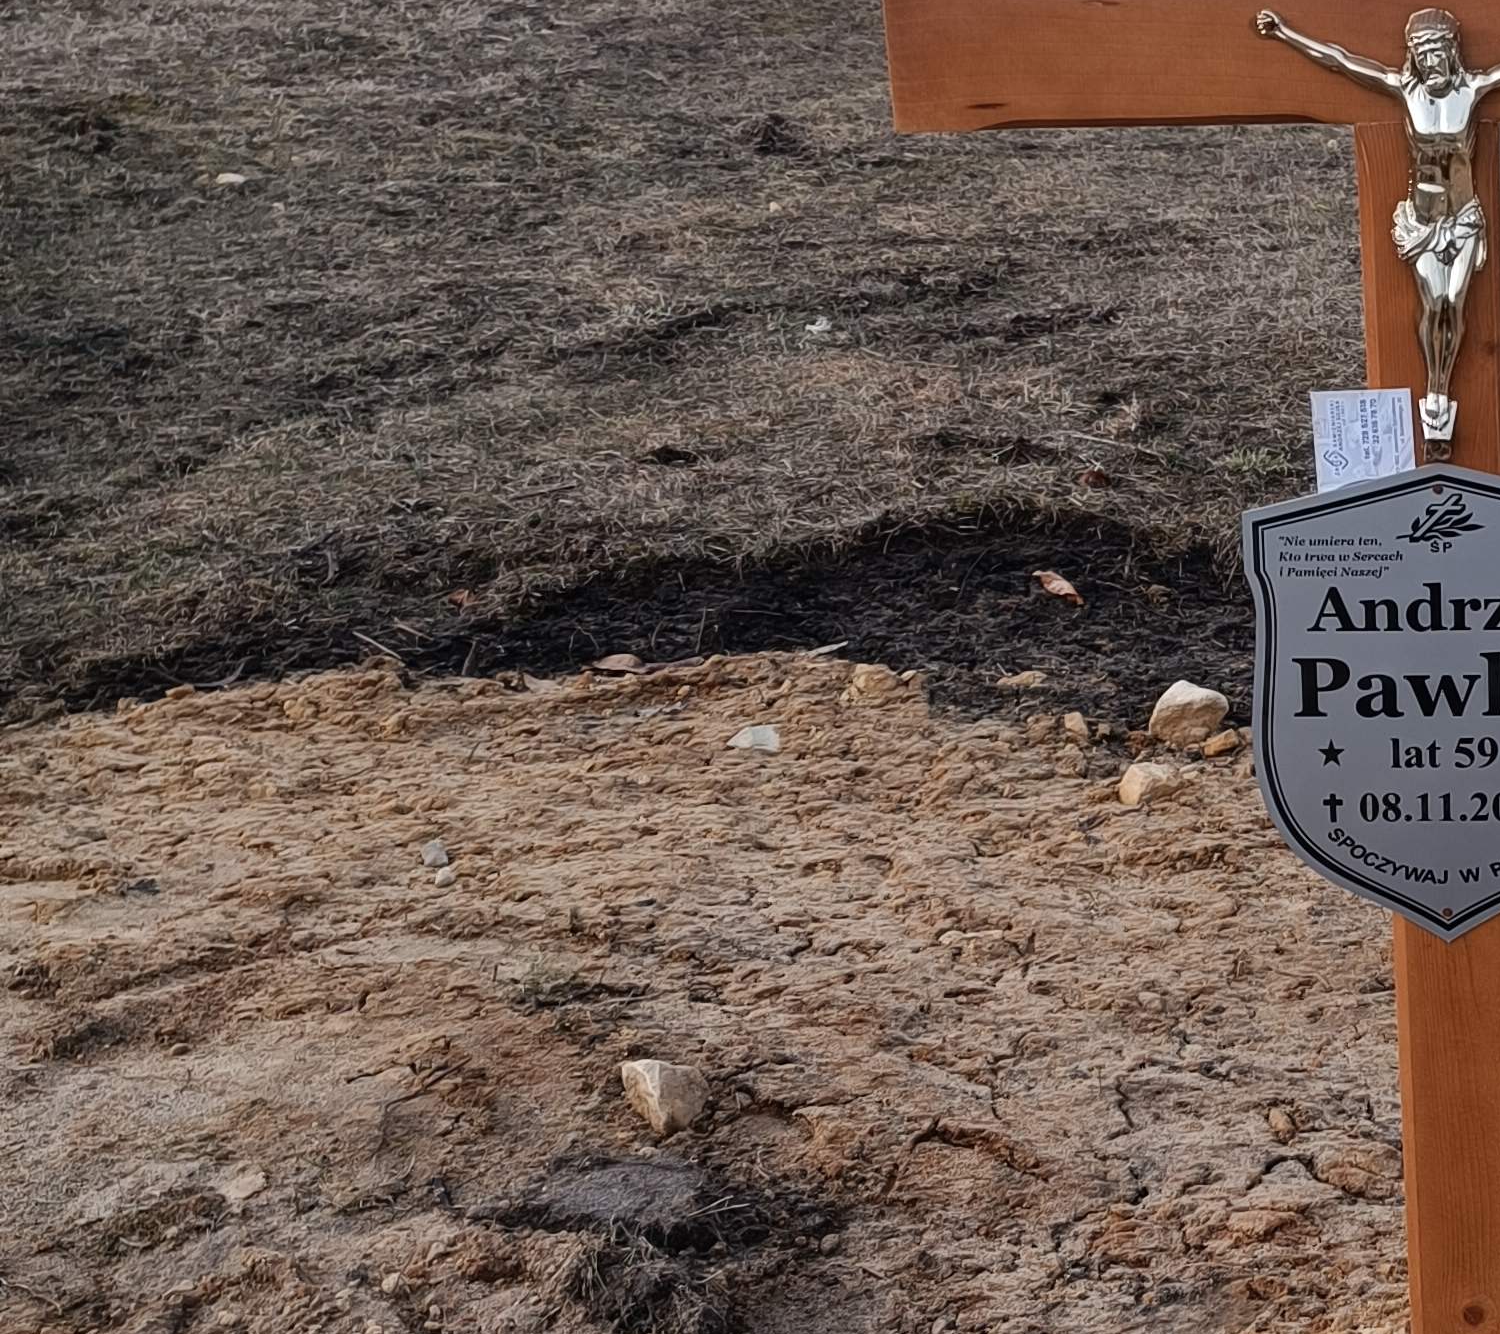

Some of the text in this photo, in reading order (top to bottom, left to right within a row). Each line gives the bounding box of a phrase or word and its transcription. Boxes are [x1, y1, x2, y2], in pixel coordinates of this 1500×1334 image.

[1309, 536, 1355, 547] umiera
[1280, 551, 1403, 562] Kto trwa w Sercach
[1287, 567, 1338, 579] Pamięci
[1391, 737, 1499, 769] lat 59
[1328, 827, 1449, 885] SPOCZYWAJ
[1459, 867, 1480, 883] W
